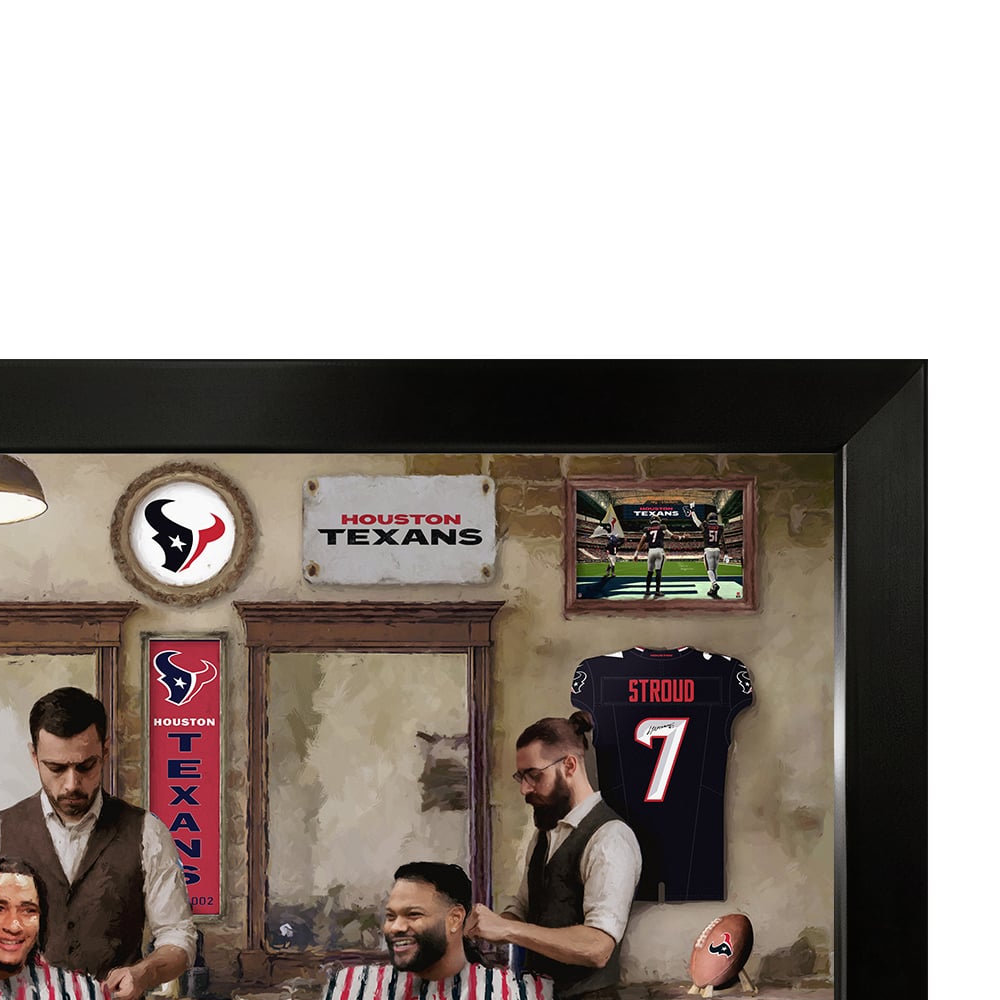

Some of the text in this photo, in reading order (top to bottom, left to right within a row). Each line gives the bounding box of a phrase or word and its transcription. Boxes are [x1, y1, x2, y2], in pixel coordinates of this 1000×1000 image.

[341, 514, 461, 525] HOUSTON
[318, 528, 483, 546] TEXANS
[650, 530, 658, 543] 7
[709, 530, 718, 542] 51
[628, 679, 695, 702] STROUD
[153, 718, 216, 726] HOUSTON
[634, 717, 690, 802] 7
[191, 896, 214, 906] 002
